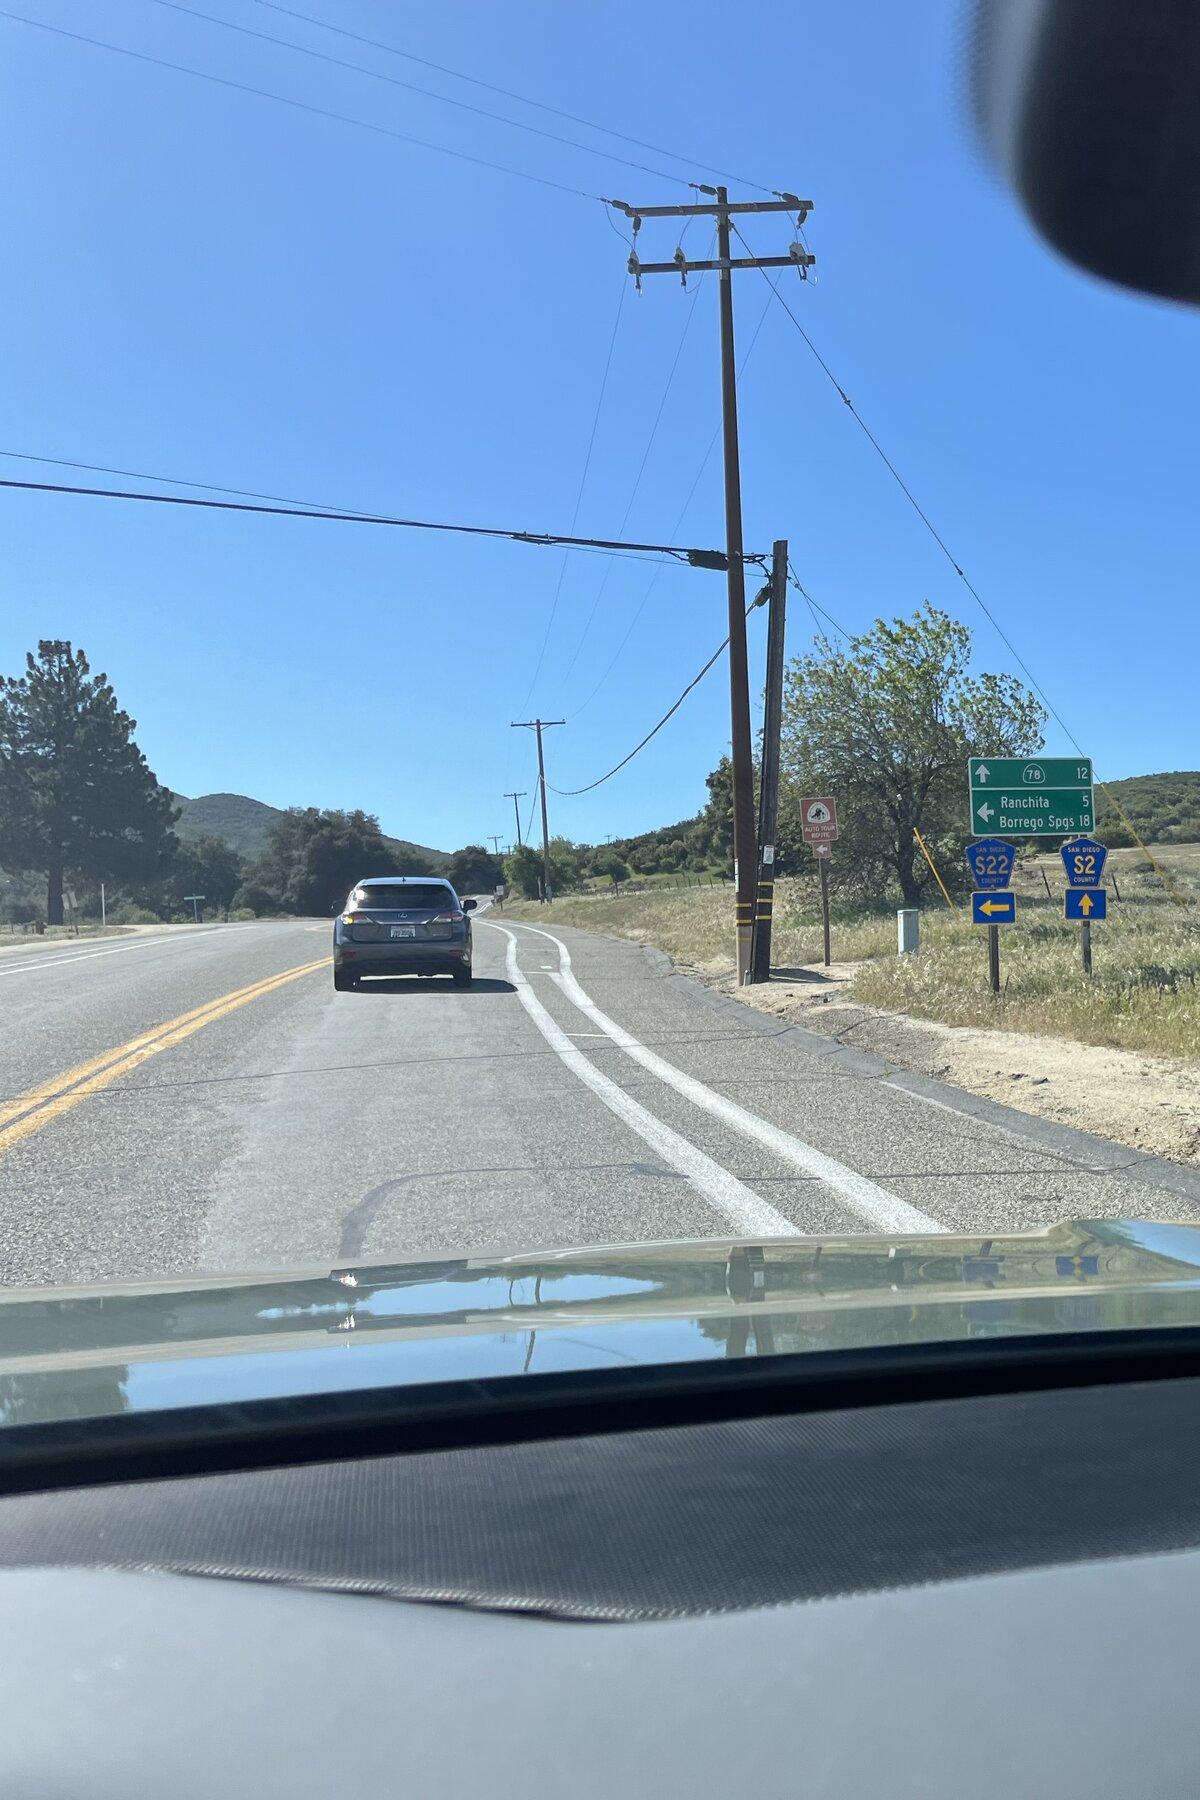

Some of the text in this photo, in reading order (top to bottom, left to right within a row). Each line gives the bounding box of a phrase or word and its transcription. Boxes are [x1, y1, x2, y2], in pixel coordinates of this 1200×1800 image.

[1026, 767, 1089, 780] 78 12
[1001, 795, 1089, 808] Ranchita 5
[821, 824, 836, 832] TOUR
[1000, 814, 1090, 831] Borrego Spgs 18
[976, 855, 1009, 875] S22
[1074, 855, 1095, 874] S2
